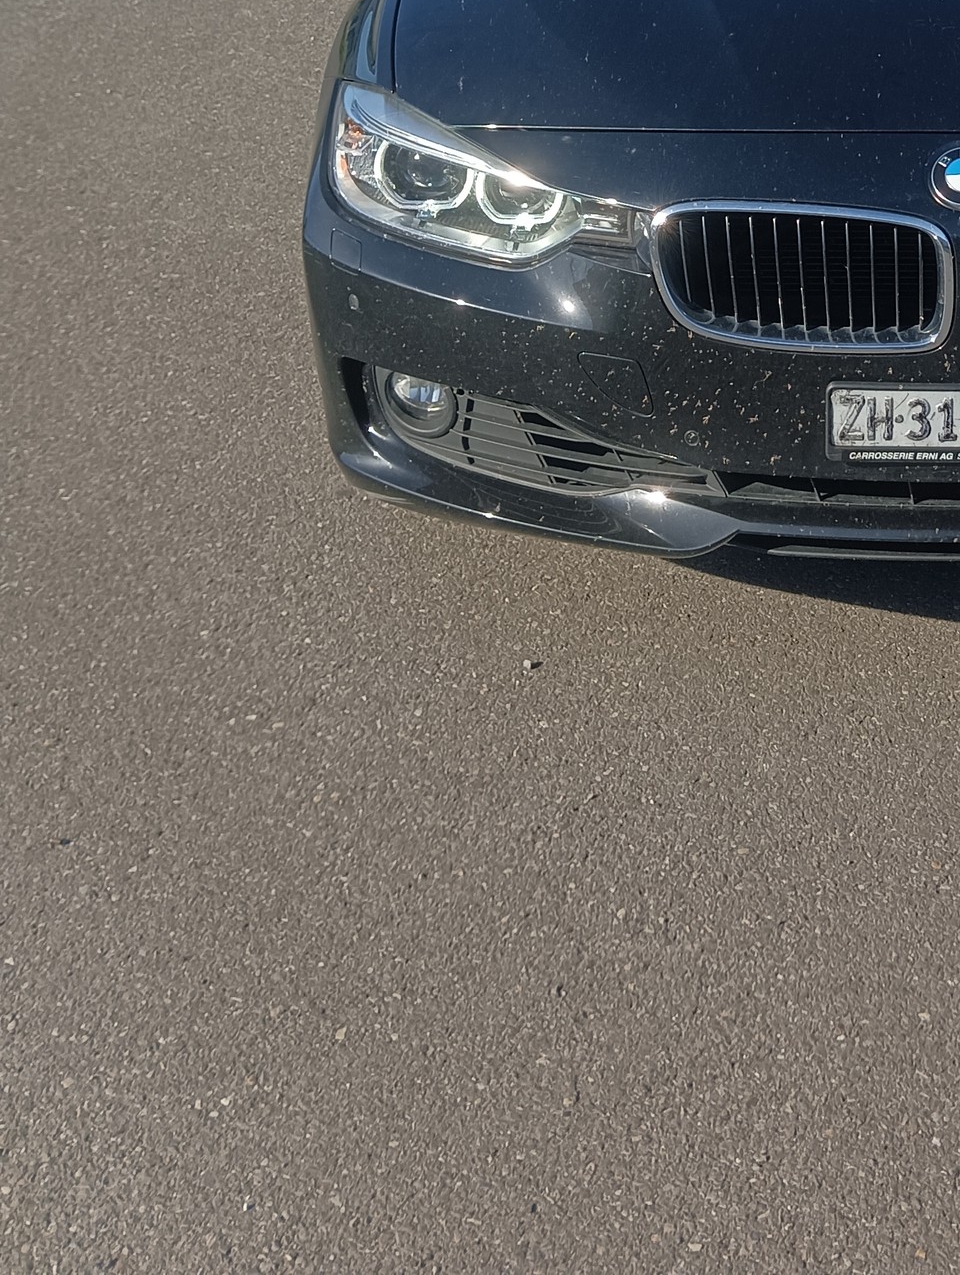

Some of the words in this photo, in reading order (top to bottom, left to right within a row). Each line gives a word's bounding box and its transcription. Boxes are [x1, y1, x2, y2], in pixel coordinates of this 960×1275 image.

[849, 452, 915, 460] CARROSSERIE
[916, 452, 938, 460] ERNI
[939, 452, 954, 460] AG
